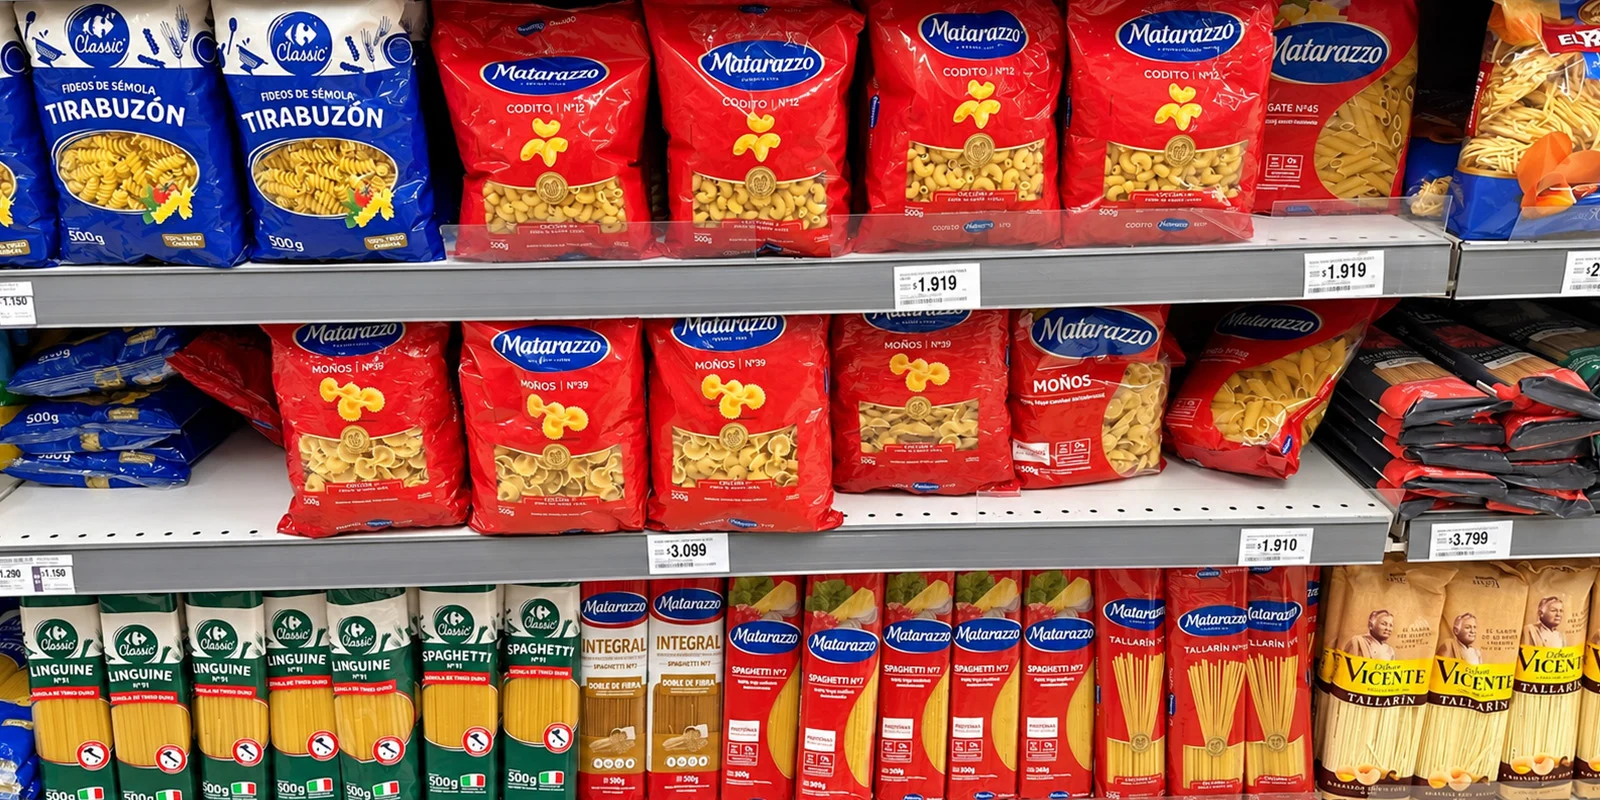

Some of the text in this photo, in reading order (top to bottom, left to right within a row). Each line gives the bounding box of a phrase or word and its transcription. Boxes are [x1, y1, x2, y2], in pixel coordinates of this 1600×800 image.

[928, 17, 1021, 44] Matarazzo
[1127, 20, 1234, 46] Matarazzo
[75, 35, 125, 55] Classic
[1273, 35, 1383, 64] Matarazzo
[277, 43, 328, 64] Classic
[709, 47, 814, 73] Matarazzo
[492, 63, 599, 83] Matarazzo
[943, 67, 987, 76] CODITO
[1144, 70, 1189, 80] CODITO
[62, 81, 156, 95] FIDEOS DE SÉMOLA
[261, 88, 354, 101] FIDEOS DE SÉMOLA
[507, 103, 552, 114] CODITO
[722, 97, 767, 108] CODITO
[45, 96, 185, 128] TIRABUZÓN
[242, 102, 383, 133] TIRABUZÓN
[904, 209, 924, 218] 500g
[1099, 209, 1118, 218] 500g
[694, 234, 712, 243] 500g
[490, 242, 509, 251] 500g
[302, 323, 397, 343] Matarazzo
[682, 317, 777, 337] Matarazzo
[1039, 317, 1153, 346] Matarazzo
[501, 335, 601, 357] Matarazzo
[885, 340, 922, 349] MOÑOS
[312, 364, 351, 374] MOÑOS
[695, 359, 735, 369] MOÑOS
[521, 379, 556, 391] MOÑOS
[1033, 374, 1092, 393] MOÑOS
[26, 412, 59, 425] 500g
[1448, 532, 1488, 547] $3.799
[666, 544, 706, 557] $3.099
[584, 600, 646, 613] Matarazzo
[658, 596, 720, 610] Matarazzo
[525, 616, 557, 629] Classic
[1187, 613, 1247, 628] Matarazzo
[276, 627, 310, 640] Classic
[438, 624, 471, 637] Classic
[734, 628, 798, 644] Matarazzo
[886, 626, 950, 642] Matarazzo
[956, 626, 1020, 641] Matarazzo
[1029, 626, 1094, 641] Matarazzo
[41, 639, 75, 651] Classic
[201, 639, 235, 651] Classic
[342, 634, 374, 648] Classic
[582, 636, 646, 654] INTEGRAL
[657, 636, 720, 650] INTEGRAL
[812, 635, 876, 652] Matarazzo
[1110, 635, 1155, 647] TALLARÍN
[119, 644, 156, 657] Classic
[507, 643, 574, 657] SPAGHETTI
[1184, 643, 1229, 654] TALLARÍN
[269, 653, 326, 665] LINGUINE
[422, 650, 492, 663] SPAGHETTI
[1519, 650, 1584, 673] VICENT
[30, 664, 93, 677] LINGUINE
[193, 664, 251, 676] LINGUINE
[332, 659, 390, 671] LINGUINE
[732, 666, 769, 675] SPAGHETTI
[884, 664, 926, 672] SPAGHETTI
[954, 664, 994, 672] SPAGHETTI
[1028, 664, 1068, 672] SPAGHETTI
[1344, 657, 1426, 685] VICENTE
[109, 671, 172, 682] LINGUINE
[808, 674, 847, 683] SPAGHETTI
[1437, 659, 1514, 691] VICENTE
[1348, 693, 1416, 705] TALLARÍN
[1440, 695, 1509, 712] TALLARÍN
[429, 776, 458, 789] 500g
[508, 772, 536, 785] 500g
[46, 792, 75, 800] 500g
[203, 782, 229, 797] 500g
[278, 783, 305, 796] 500g
[346, 785, 371, 800] 500g
